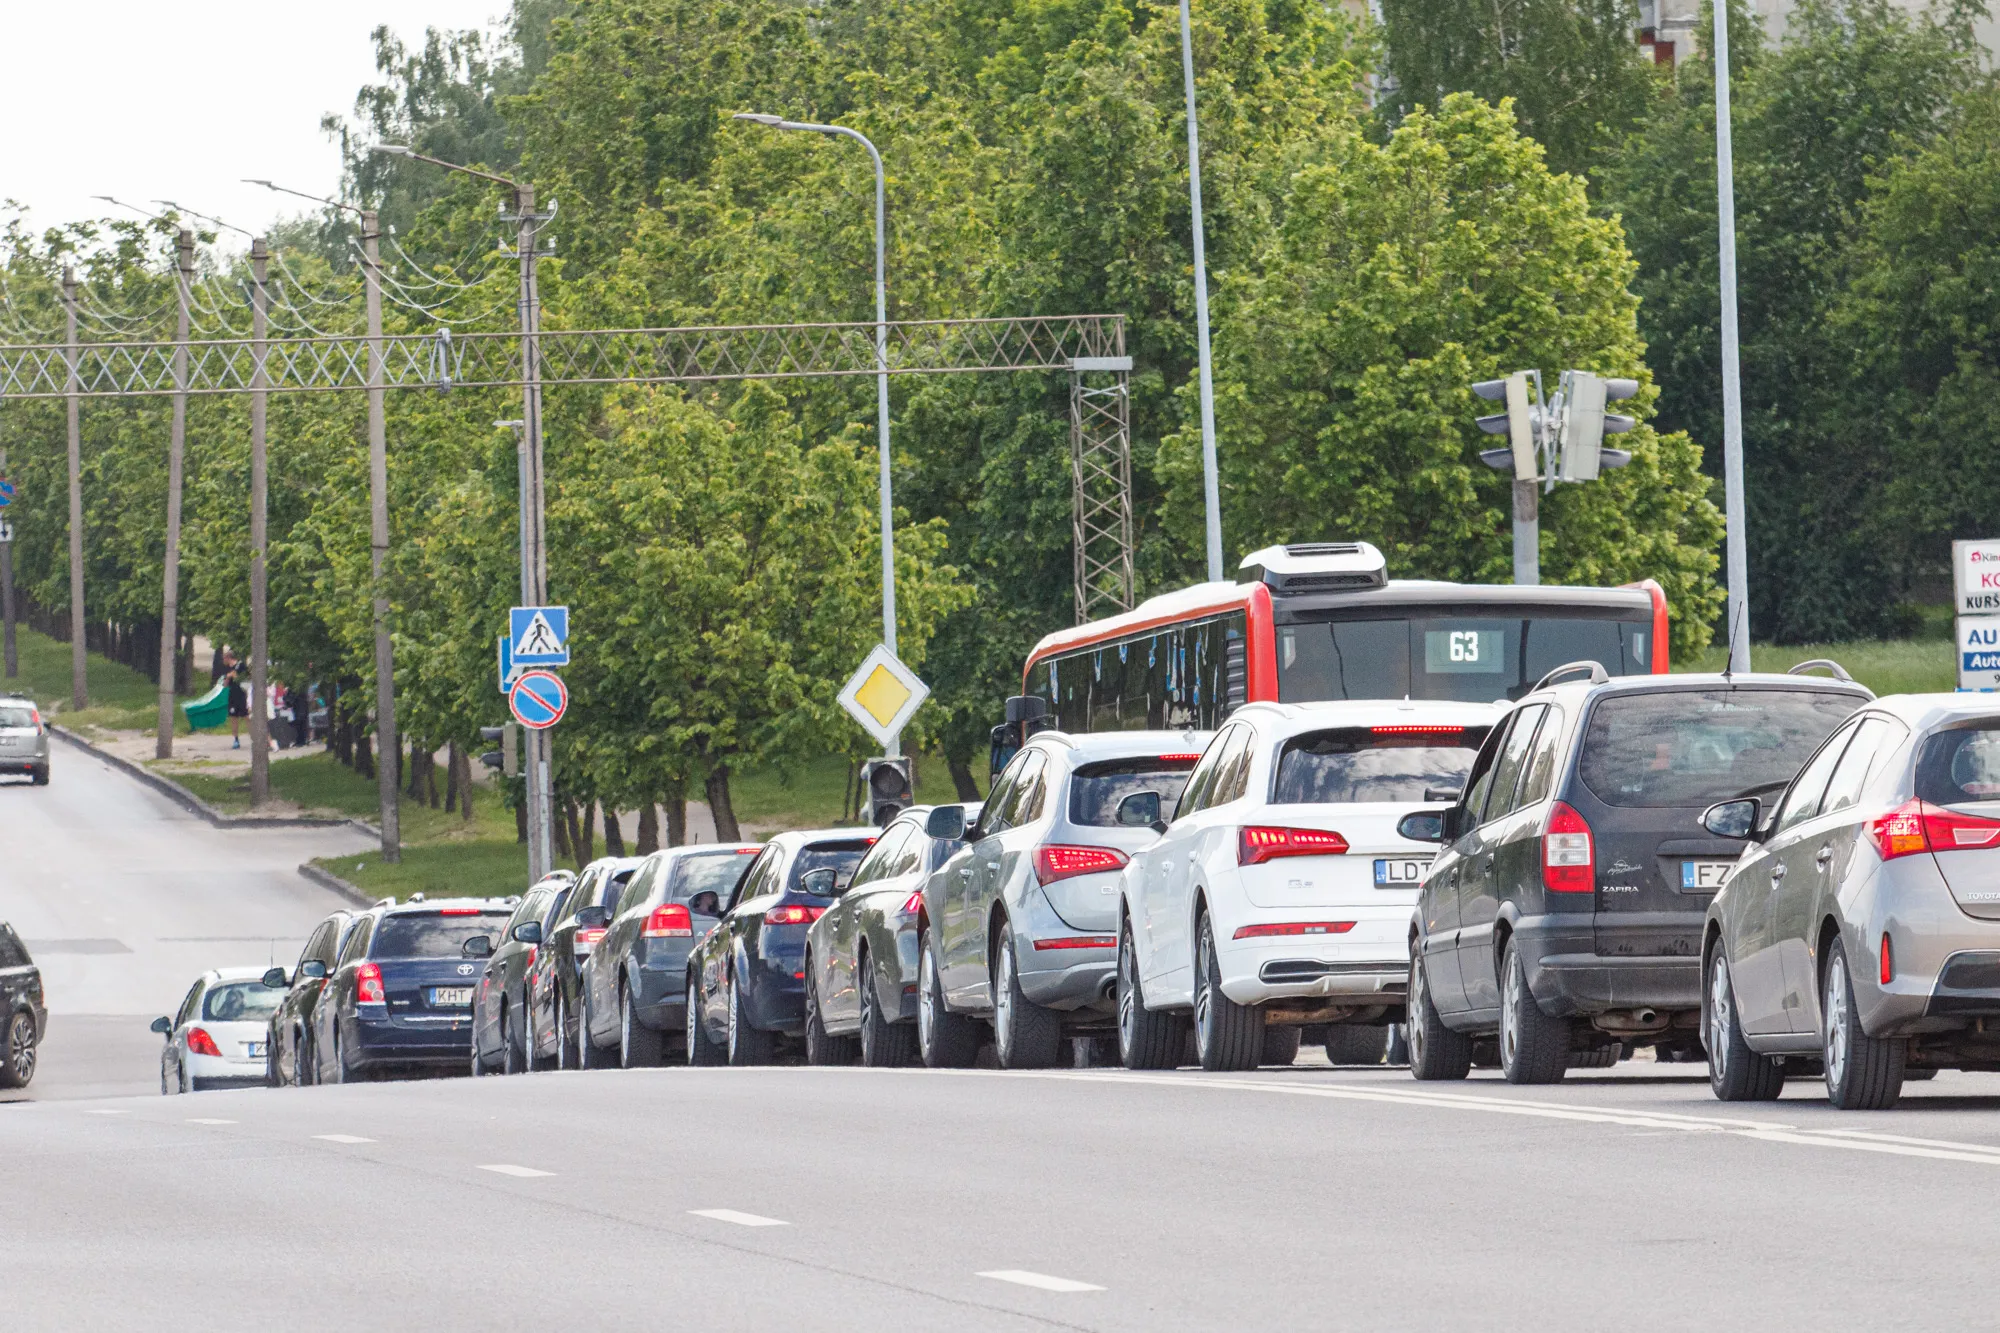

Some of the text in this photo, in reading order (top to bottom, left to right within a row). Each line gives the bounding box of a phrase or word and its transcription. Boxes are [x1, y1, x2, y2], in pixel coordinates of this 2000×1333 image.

[1966, 592, 2000, 609] KURŠ
[1967, 629, 1997, 645] AU
[1449, 631, 1479, 662] 63
[1389, 862, 1433, 881] LDT
[1684, 864, 1737, 886] LT FZ
[437, 989, 466, 1002] KHT
